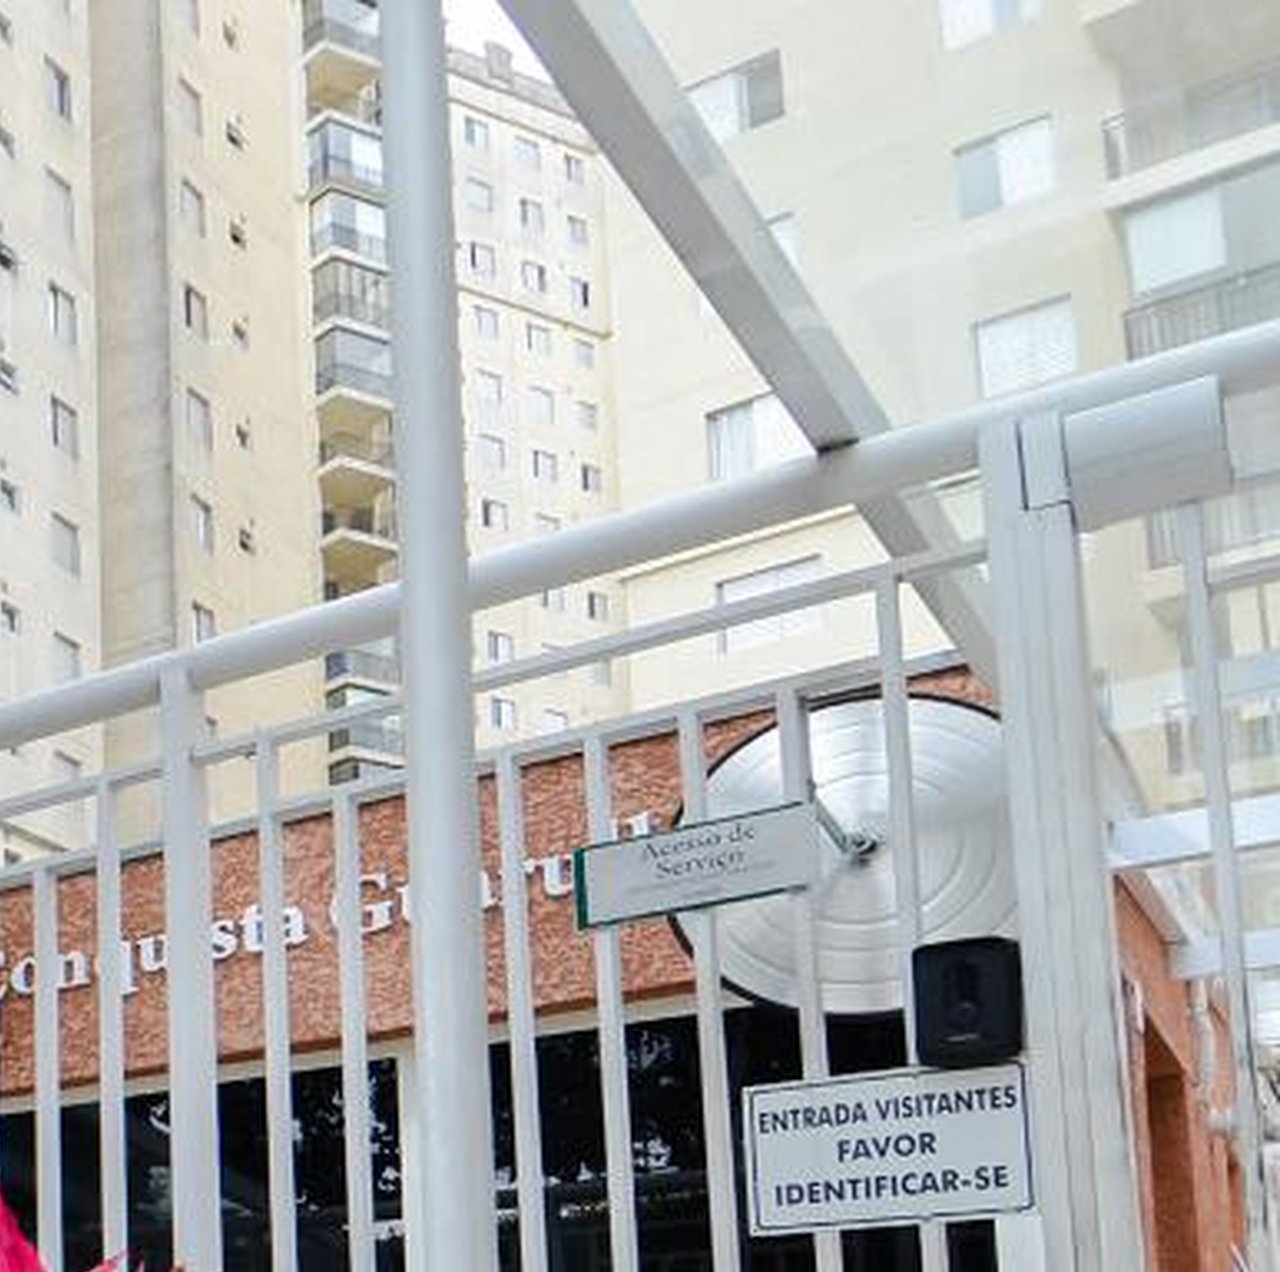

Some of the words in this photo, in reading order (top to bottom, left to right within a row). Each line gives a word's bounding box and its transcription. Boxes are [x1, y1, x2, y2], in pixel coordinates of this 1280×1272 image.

[642, 833, 721, 860] Acesso
[729, 824, 755, 843] de
[758, 1102, 868, 1134] ENTRADA
[875, 1085, 1017, 1121] VISITANTES
[836, 1132, 938, 1163] FAVOR
[775, 1165, 1010, 1207] IDENTIFICAR-SE
